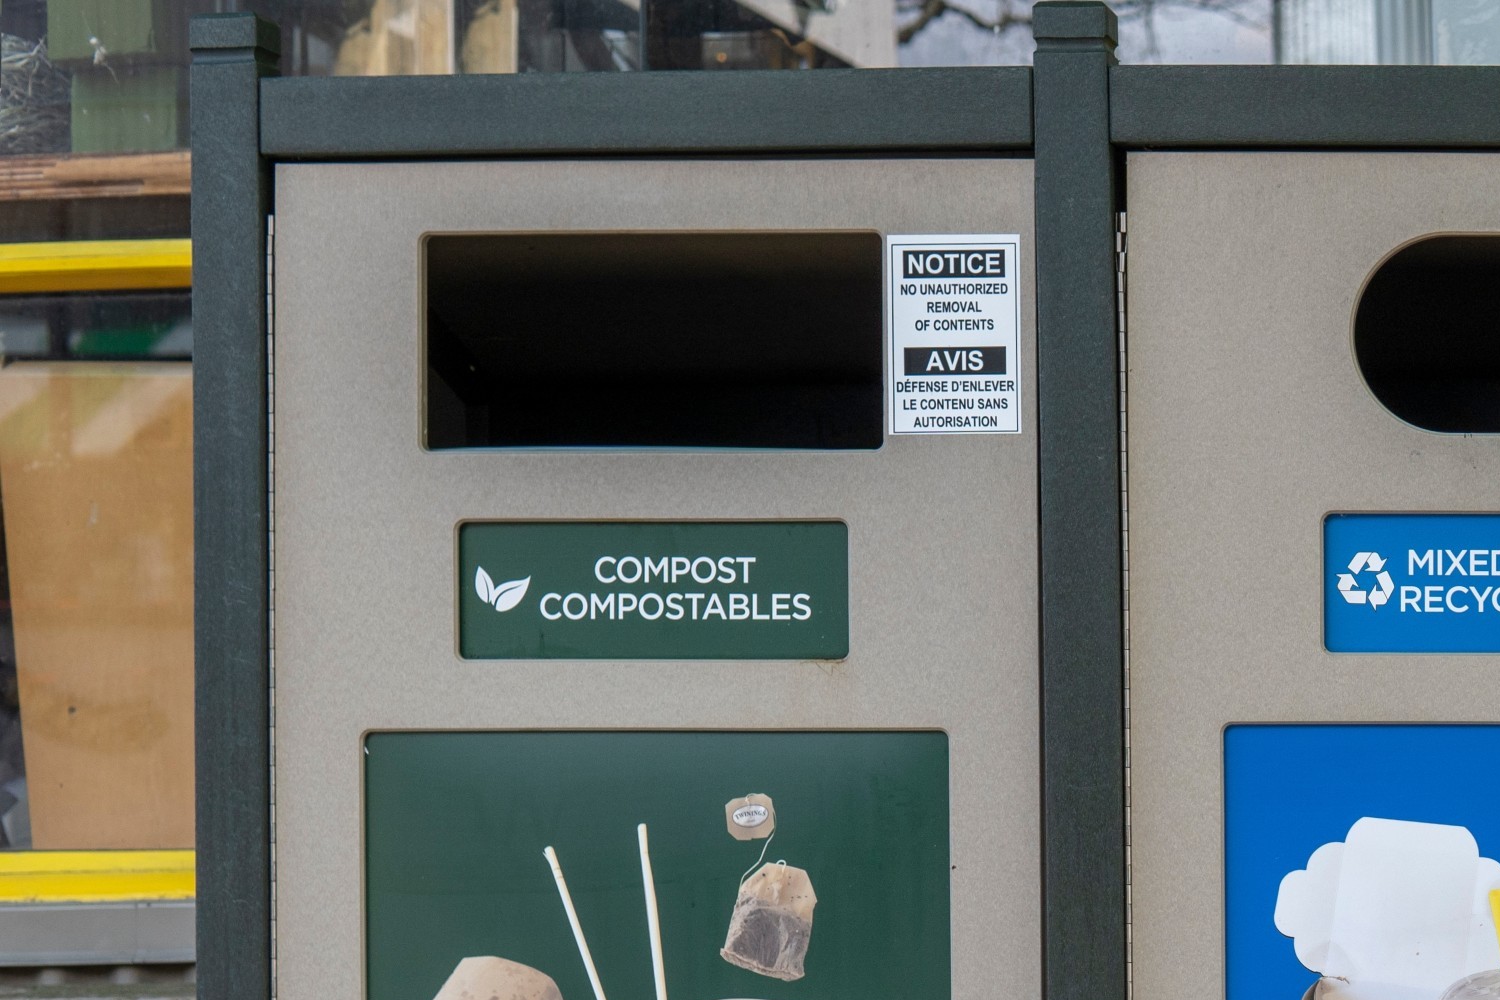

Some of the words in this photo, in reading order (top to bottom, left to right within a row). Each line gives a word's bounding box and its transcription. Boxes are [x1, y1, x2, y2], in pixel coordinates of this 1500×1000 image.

[908, 253, 1001, 274] NOTICE
[901, 284, 917, 295] NO
[920, 283, 1008, 295] UNAUTHORIZED
[927, 301, 982, 313] REMOVAL
[915, 320, 930, 331] OF
[933, 319, 994, 331] CONTENTS
[926, 350, 984, 371] AVIS
[896, 379, 948, 392] DÉFENSE
[952, 380, 1015, 392] D'ENLEVER
[903, 399, 917, 410] LE
[920, 398, 974, 410] CONTENU
[978, 398, 1008, 409] SANS
[914, 416, 998, 427] AUTORISATION
[594, 556, 756, 584] COMPOST
[539, 592, 812, 621] COMPOSTABLES
[735, 810, 766, 820] TWININGS
